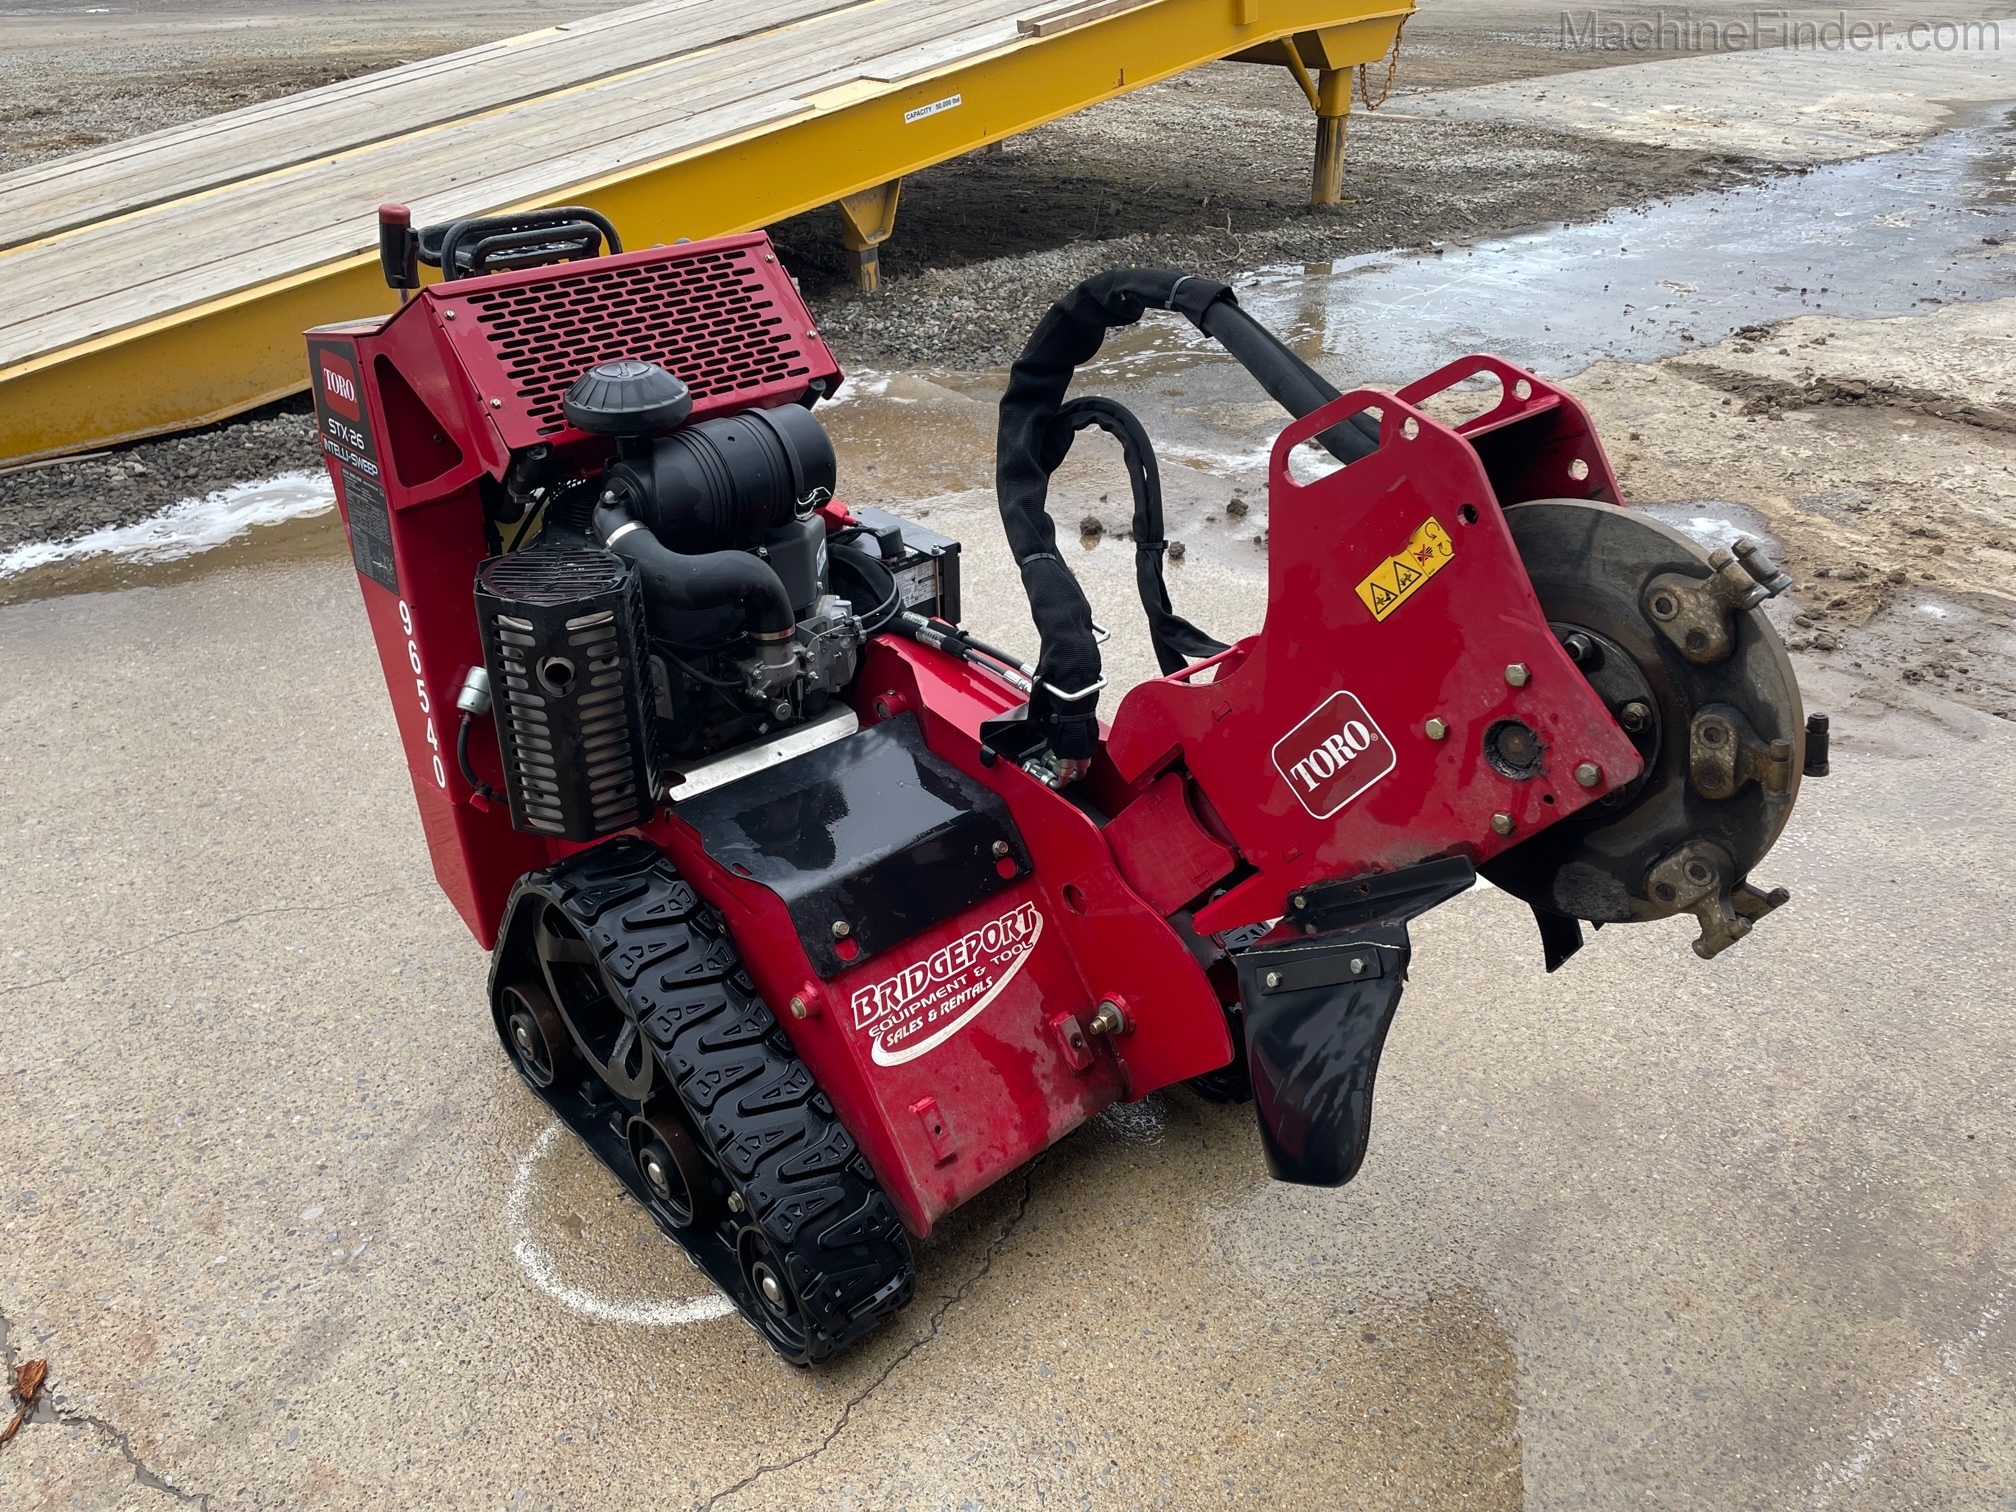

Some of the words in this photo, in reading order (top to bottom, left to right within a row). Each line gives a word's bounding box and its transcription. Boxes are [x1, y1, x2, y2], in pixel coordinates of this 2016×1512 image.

[906, 106, 932, 120] CAPACITY
[936, 99, 951, 109] 50,000
[323, 368, 355, 402] TORO
[323, 437, 378, 477] INTELLI-SWEEP
[398, 599, 446, 788] 96540
[1289, 720, 1371, 793] TORO
[851, 900, 1035, 1030] BRIDGEPORT
[868, 973, 968, 1037] EQUIPMENT
[973, 965, 986, 977] &
[989, 941, 1033, 966] TOOL
[886, 1015, 924, 1048] SALES
[927, 1009, 938, 1022] &
[939, 975, 994, 1016] RENTALS
